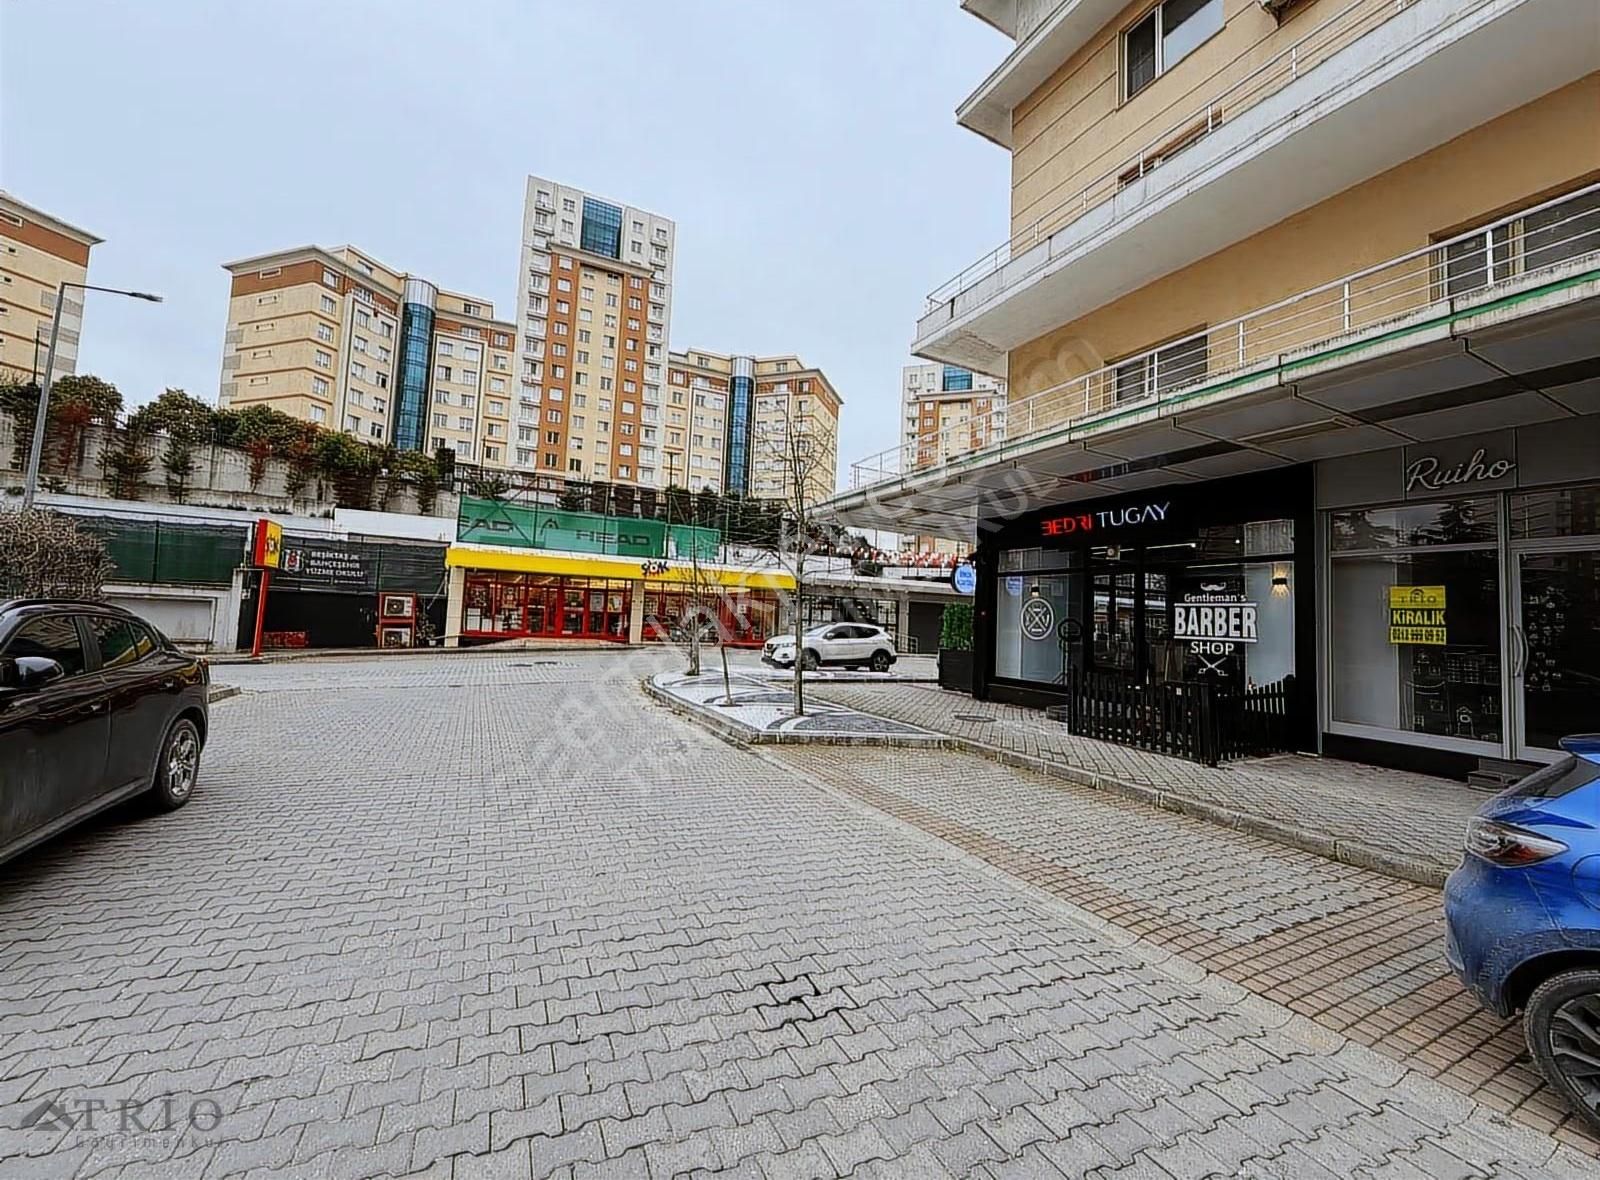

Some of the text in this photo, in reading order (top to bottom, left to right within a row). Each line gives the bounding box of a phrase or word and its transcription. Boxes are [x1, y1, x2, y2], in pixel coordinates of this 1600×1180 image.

[1406, 449, 1516, 493] Ruiho
[1096, 502, 1171, 529] TUGAY
[1184, 592, 1247, 603] Gentleman's
[1173, 607, 1258, 638] BARBER
[1190, 641, 1235, 656] SHOP
